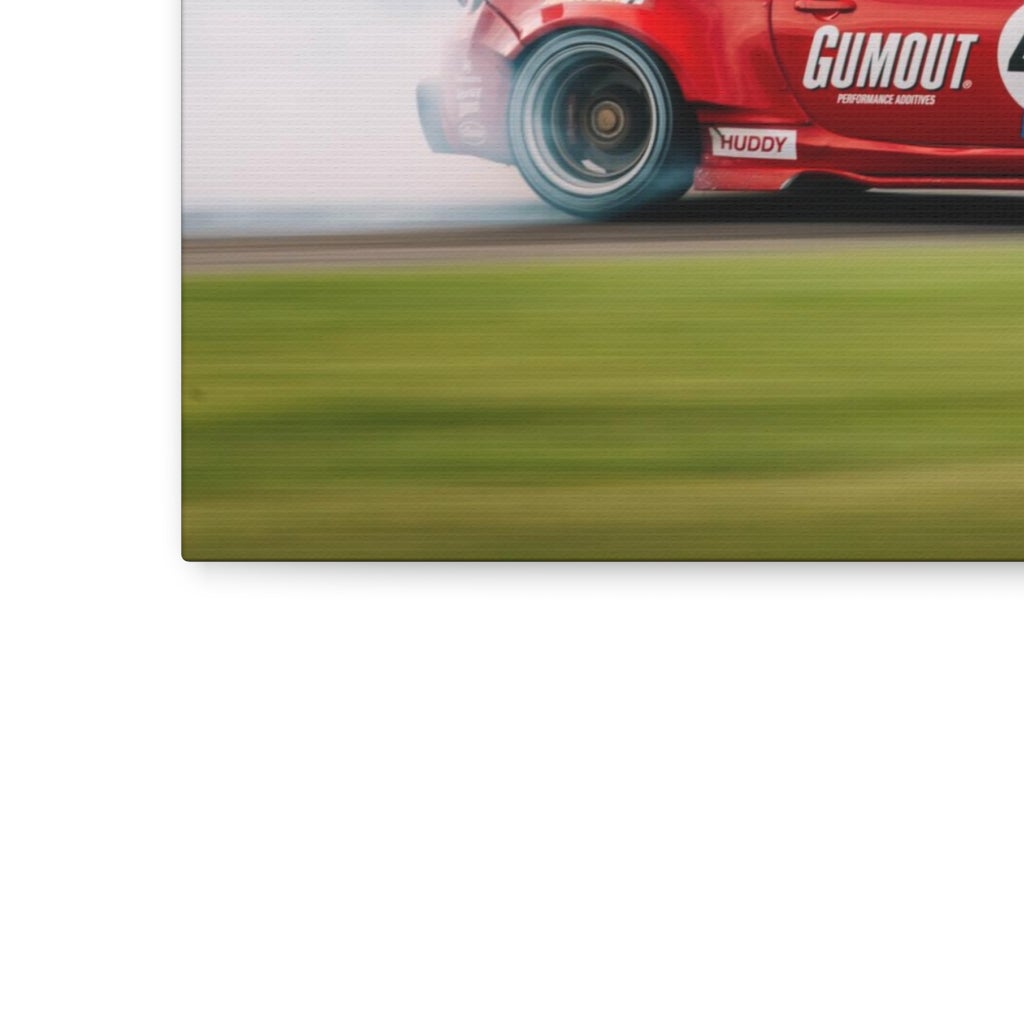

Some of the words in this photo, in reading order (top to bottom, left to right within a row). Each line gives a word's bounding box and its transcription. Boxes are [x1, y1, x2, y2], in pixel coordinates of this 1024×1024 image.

[836, 93, 894, 104] PERFORMANCE
[895, 94, 936, 105] ADDITIVES
[720, 134, 788, 153] HUDDY
